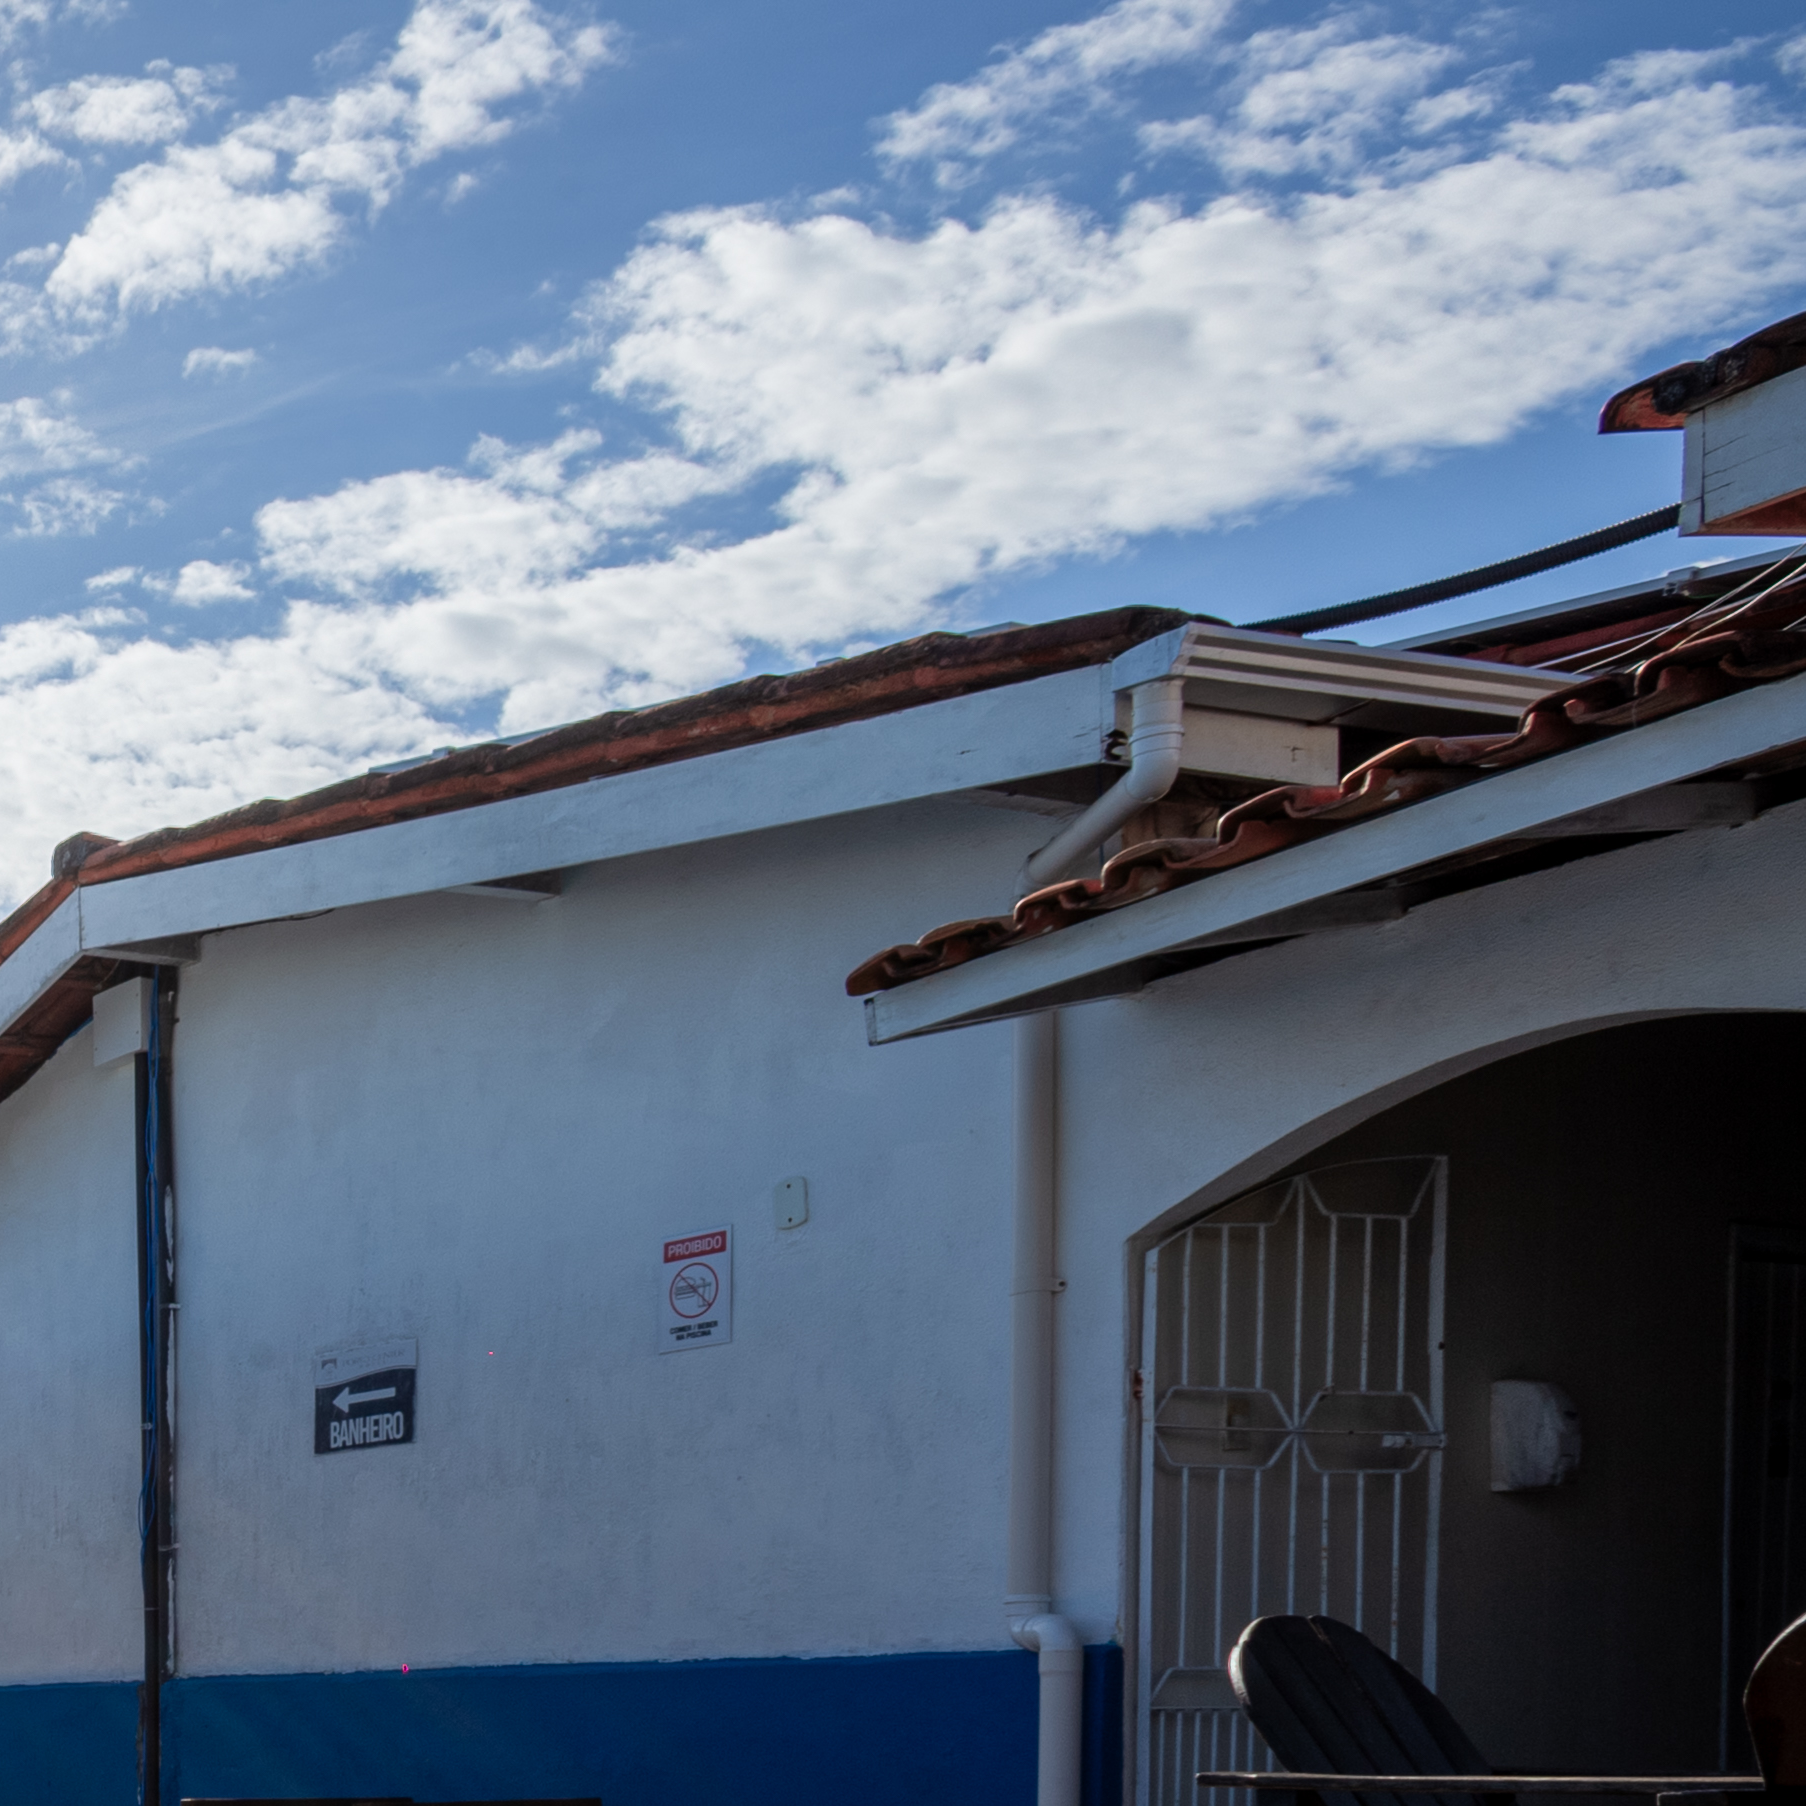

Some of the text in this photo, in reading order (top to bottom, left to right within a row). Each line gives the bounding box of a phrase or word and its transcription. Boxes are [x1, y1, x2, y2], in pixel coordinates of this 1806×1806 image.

[668, 1235, 722, 1258] PROIBIDO
[669, 1324, 692, 1334] COMER
[697, 1320, 718, 1330] BEBER
[686, 1329, 711, 1339] PISCINA
[330, 1411, 404, 1449] BANHEIRO
